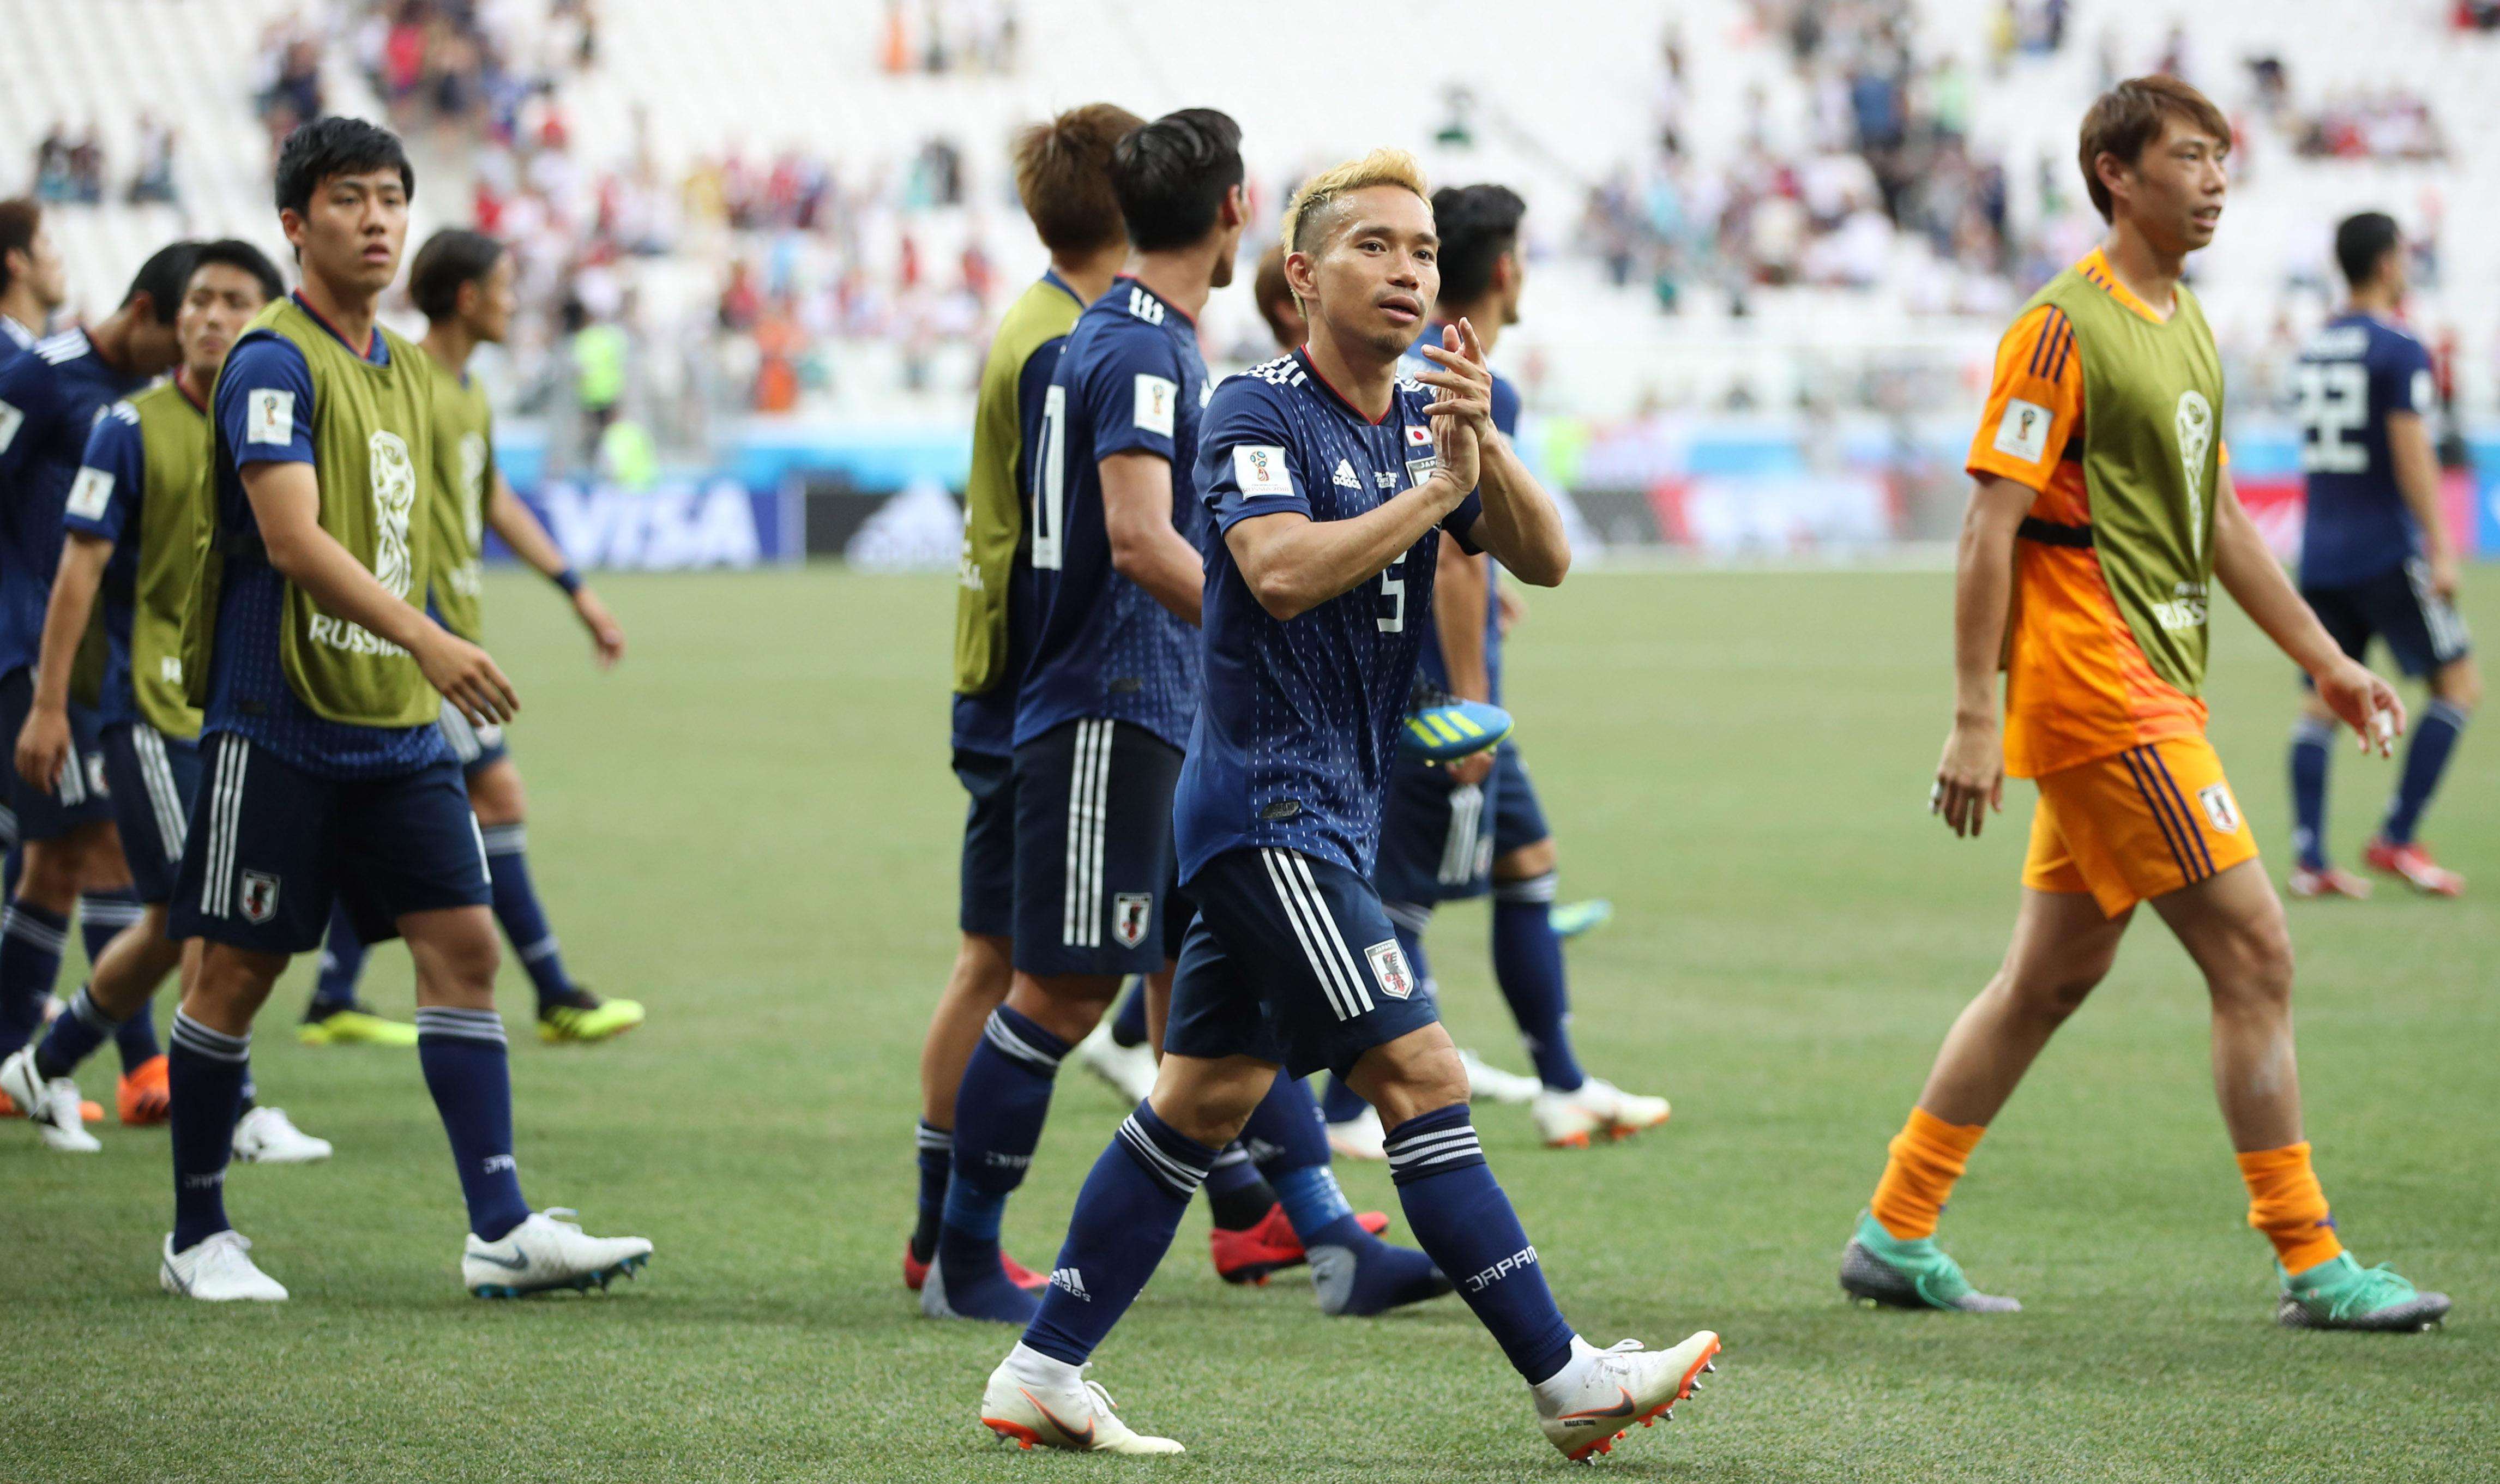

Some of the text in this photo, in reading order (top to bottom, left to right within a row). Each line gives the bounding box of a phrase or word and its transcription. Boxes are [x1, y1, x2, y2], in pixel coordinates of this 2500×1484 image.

[2298, 362, 2371, 474] 22
[1421, 460, 1437, 468] JAP
[547, 481, 761, 570] VISA
[1377, 550, 1407, 632] 5
[1049, 1274, 1092, 1302] adidas
[1466, 1245, 1538, 1293] JAPAN
